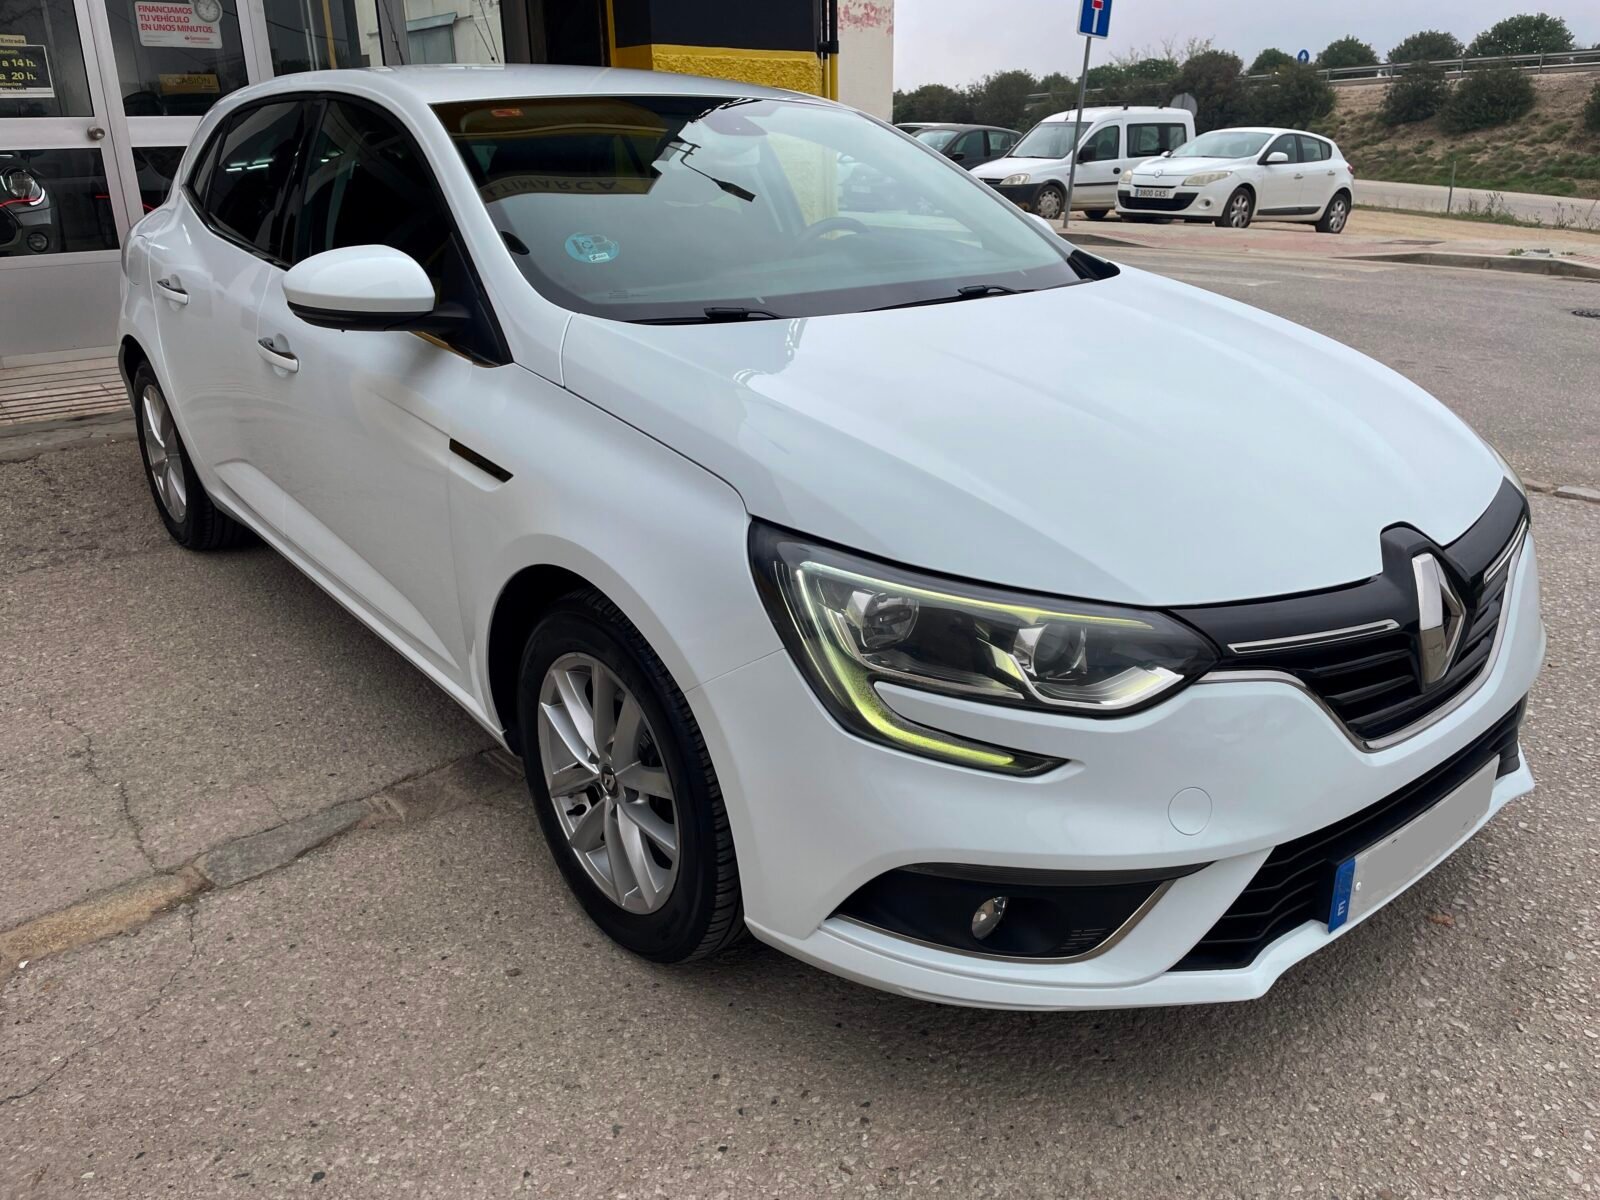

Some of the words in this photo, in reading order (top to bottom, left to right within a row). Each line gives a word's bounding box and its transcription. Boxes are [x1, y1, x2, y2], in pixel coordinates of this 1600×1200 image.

[138, 5, 193, 15] FINANCIAMOS
[139, 14, 150, 22] TU
[151, 14, 190, 23] VEHÍCULO
[141, 23, 152, 31] EN
[153, 24, 176, 32] UNOS
[11, 58, 25, 67] 14
[26, 58, 37, 67] h.
[11, 71, 25, 80] 20
[26, 71, 37, 80] h.
[1337, 900, 1346, 917] E
